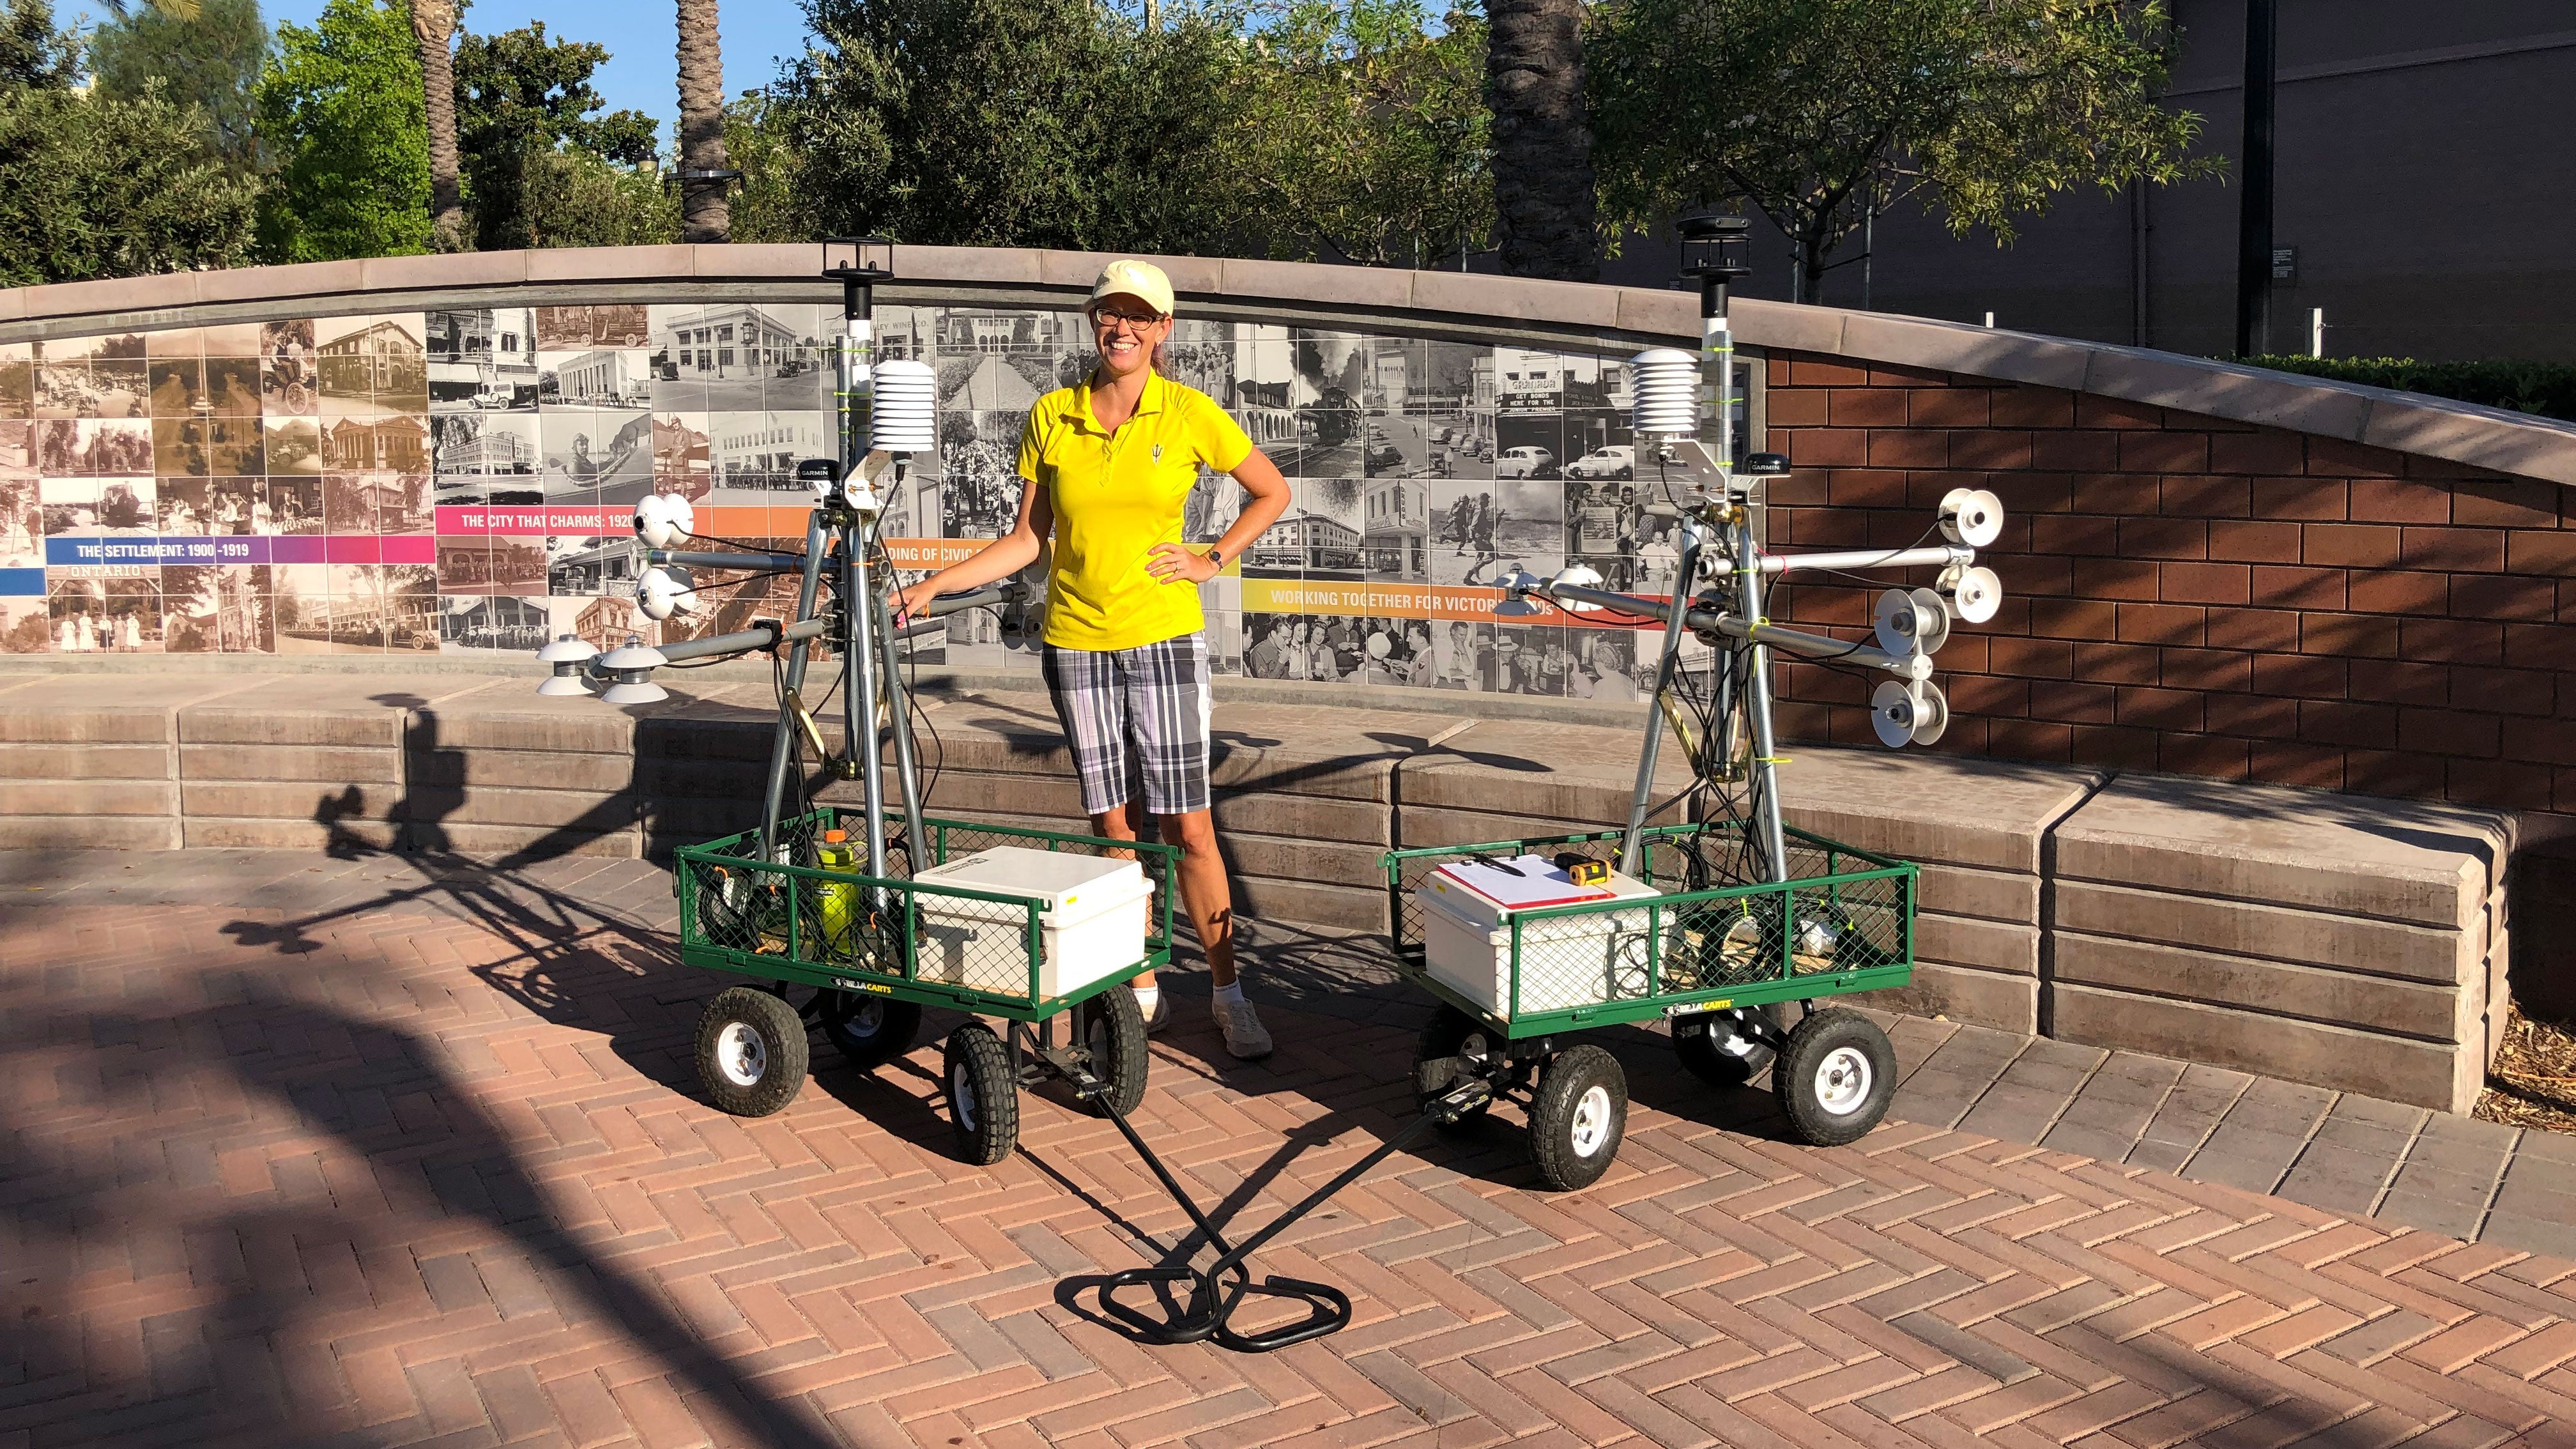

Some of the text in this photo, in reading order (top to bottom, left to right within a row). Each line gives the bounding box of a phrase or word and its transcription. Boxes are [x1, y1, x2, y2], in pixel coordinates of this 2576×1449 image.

[893, 321, 912, 329] WINE
[461, 514, 484, 528] THE
[487, 514, 514, 528] CITY
[516, 514, 546, 528] THAT
[549, 514, 605, 528] CHARMS:
[77, 543, 249, 558] THE SETTLEMENT: 1900 -1919
[923, 548, 938, 561] OF
[71, 565, 141, 578] ONTARIO
[1271, 590, 1502, 613] WORKING TOGETHER FOR VICTOR
[867, 983, 892, 993] CARTS
[1703, 999, 1731, 1010] CARTS
